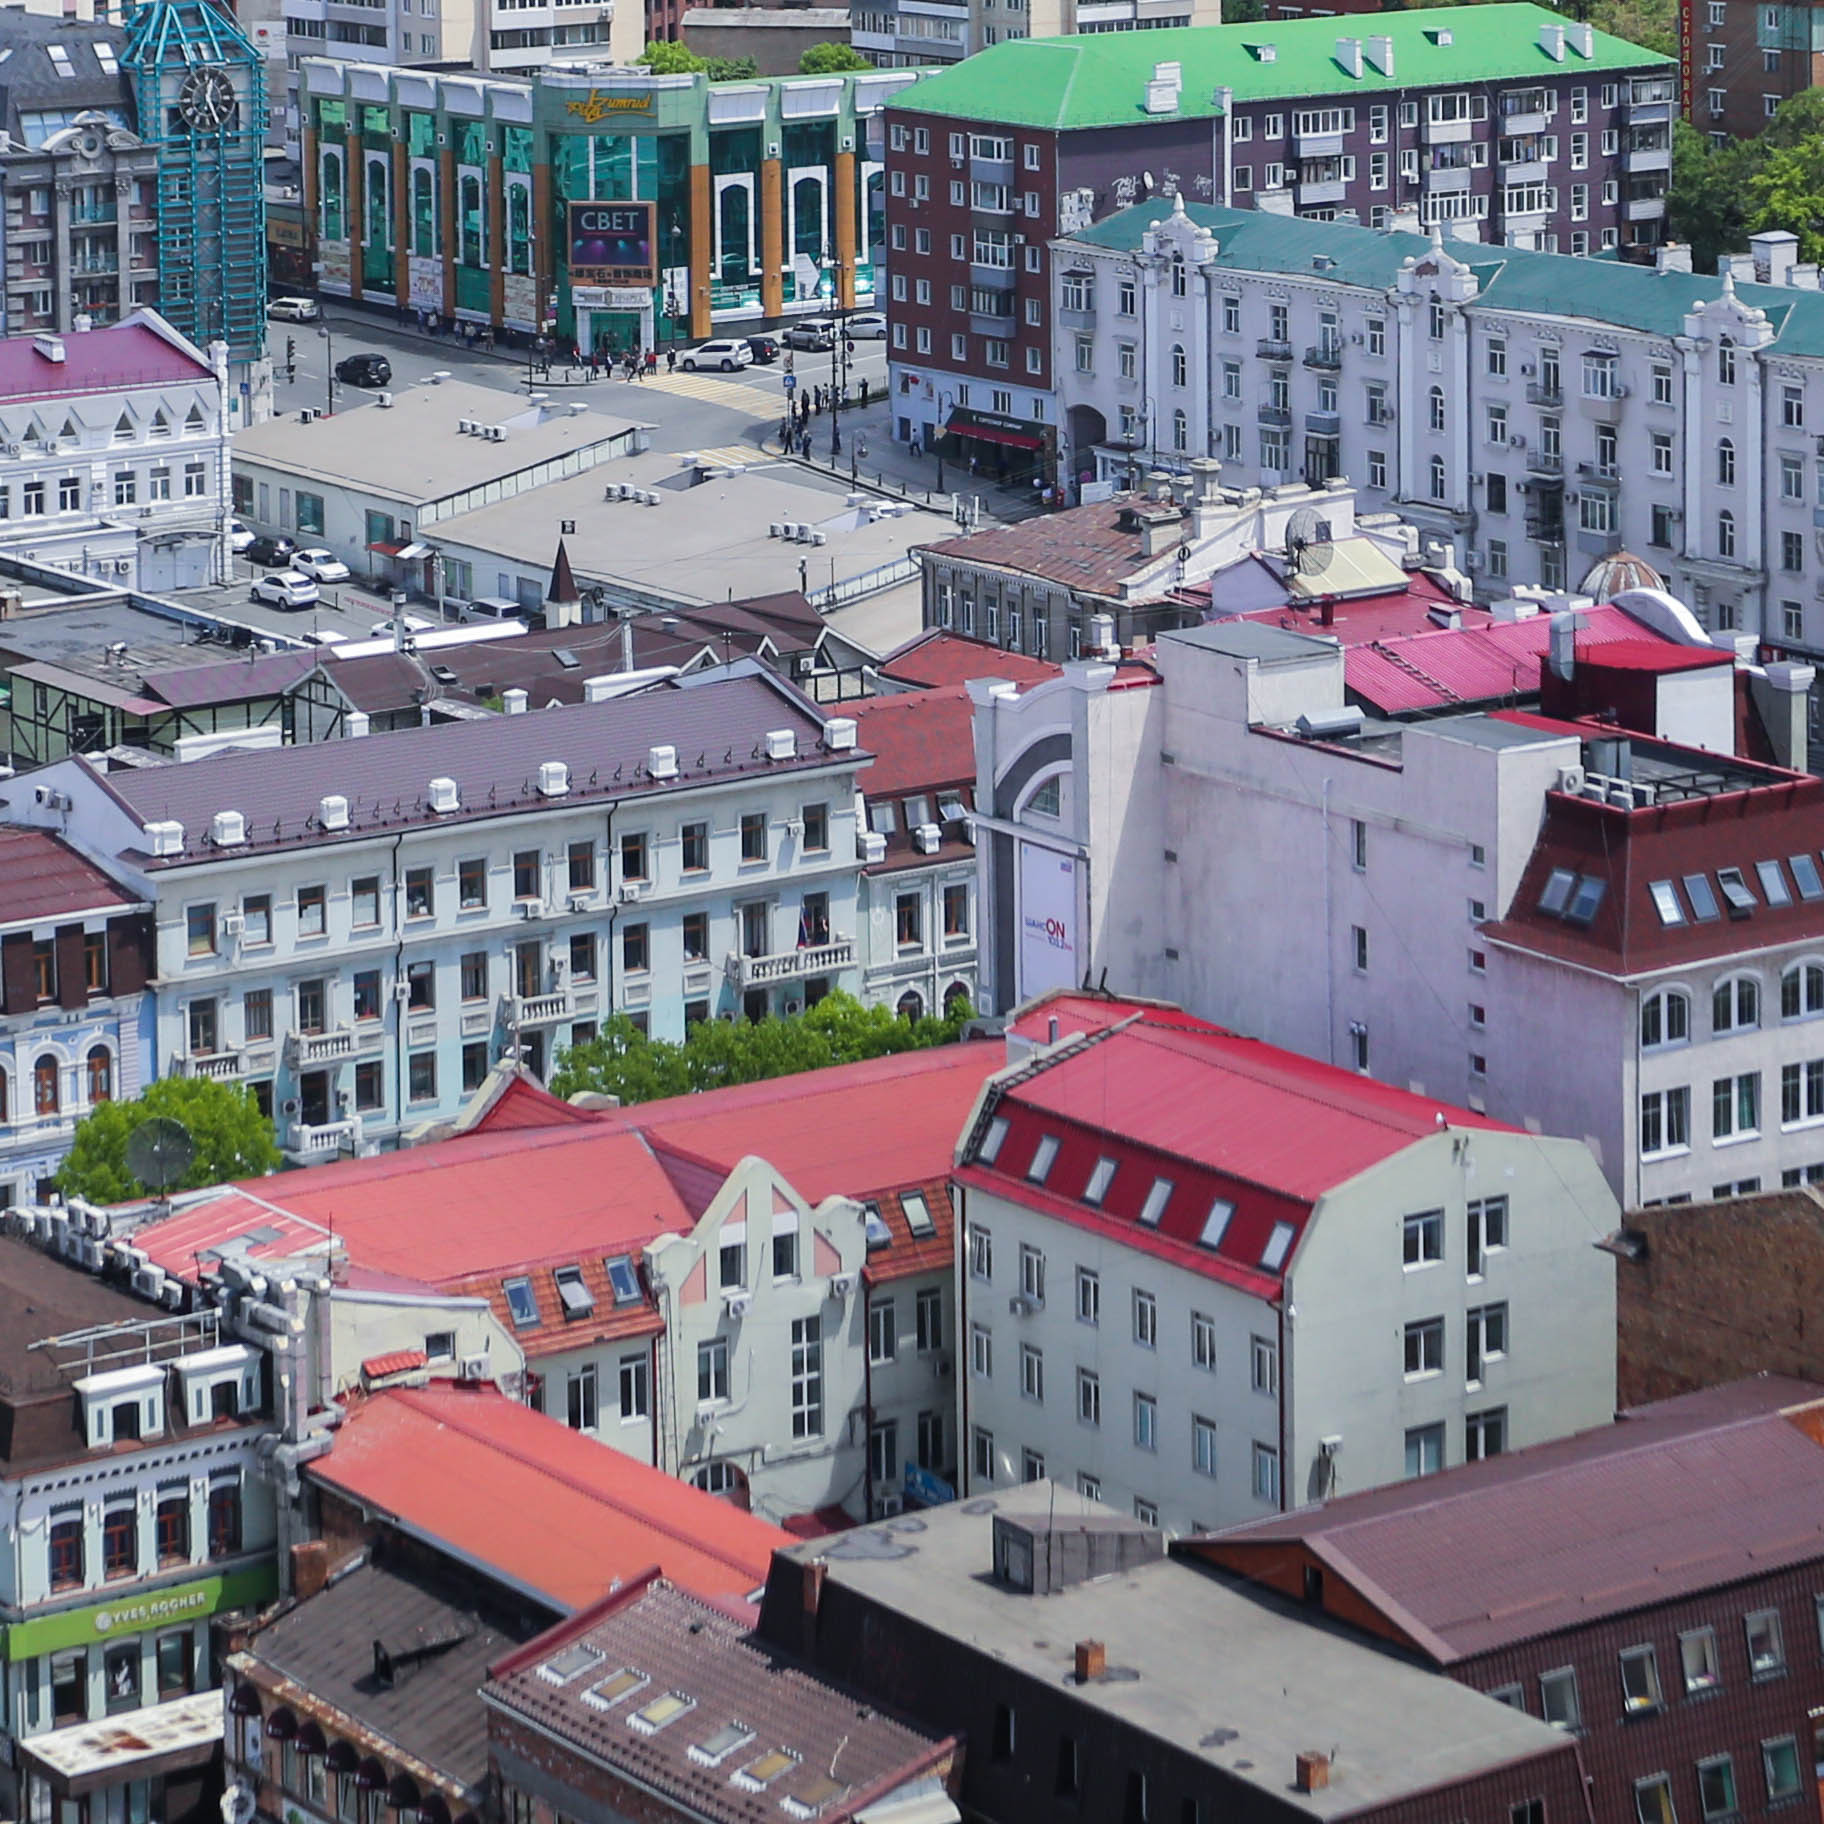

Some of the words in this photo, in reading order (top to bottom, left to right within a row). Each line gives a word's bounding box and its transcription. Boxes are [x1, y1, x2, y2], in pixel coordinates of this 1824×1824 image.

[1681, 6, 1692, 121] СТОЛОВАЯ
[580, 211, 639, 231] СВЕТ
[113, 1605, 147, 1623] YVES
[150, 1591, 206, 1615] ROCHER
